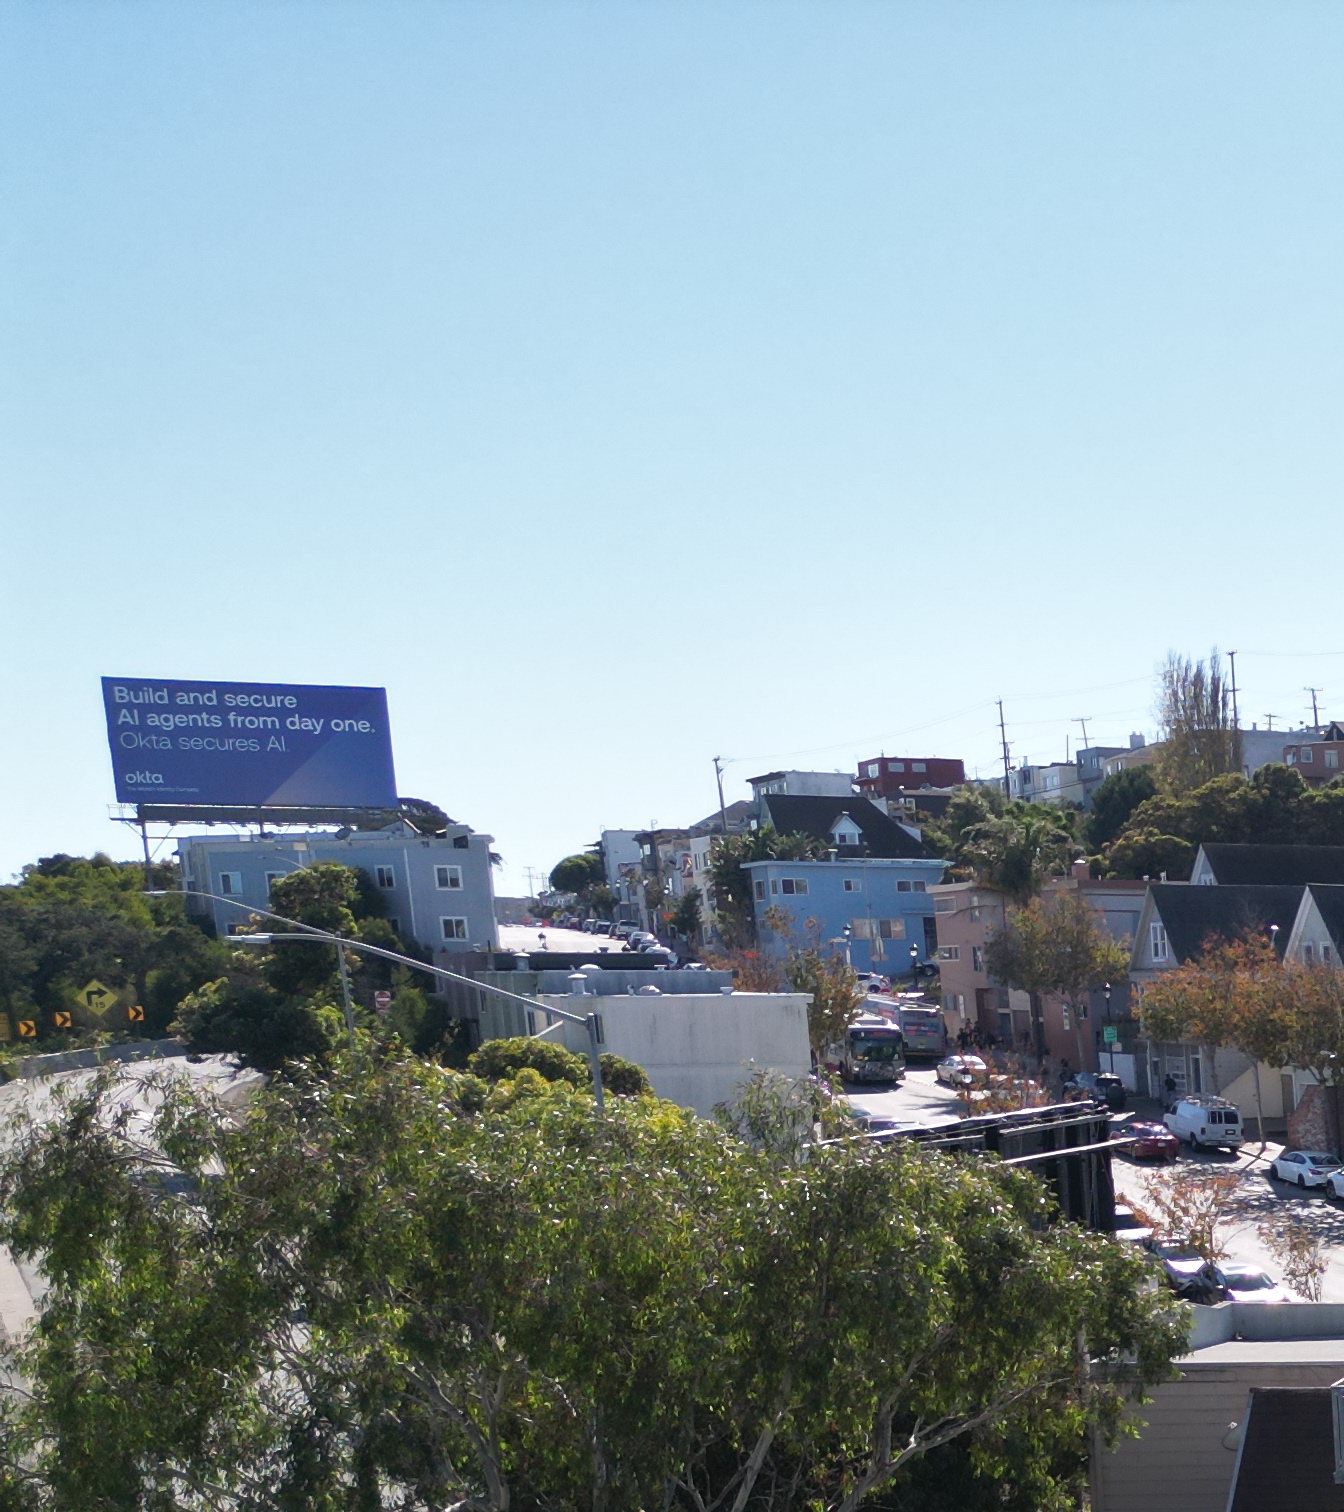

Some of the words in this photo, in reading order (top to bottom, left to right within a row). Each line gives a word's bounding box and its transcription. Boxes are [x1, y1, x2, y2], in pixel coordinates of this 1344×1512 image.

[114, 686, 168, 704] Build
[175, 689, 218, 706] and
[224, 692, 297, 709] secure
[117, 709, 139, 725] AI
[146, 710, 222, 731] agents
[227, 712, 279, 729] from
[286, 713, 324, 735] day
[330, 719, 376, 733] one.
[120, 731, 172, 750] Okta
[179, 734, 260, 752] secures
[125, 770, 164, 784] okta
